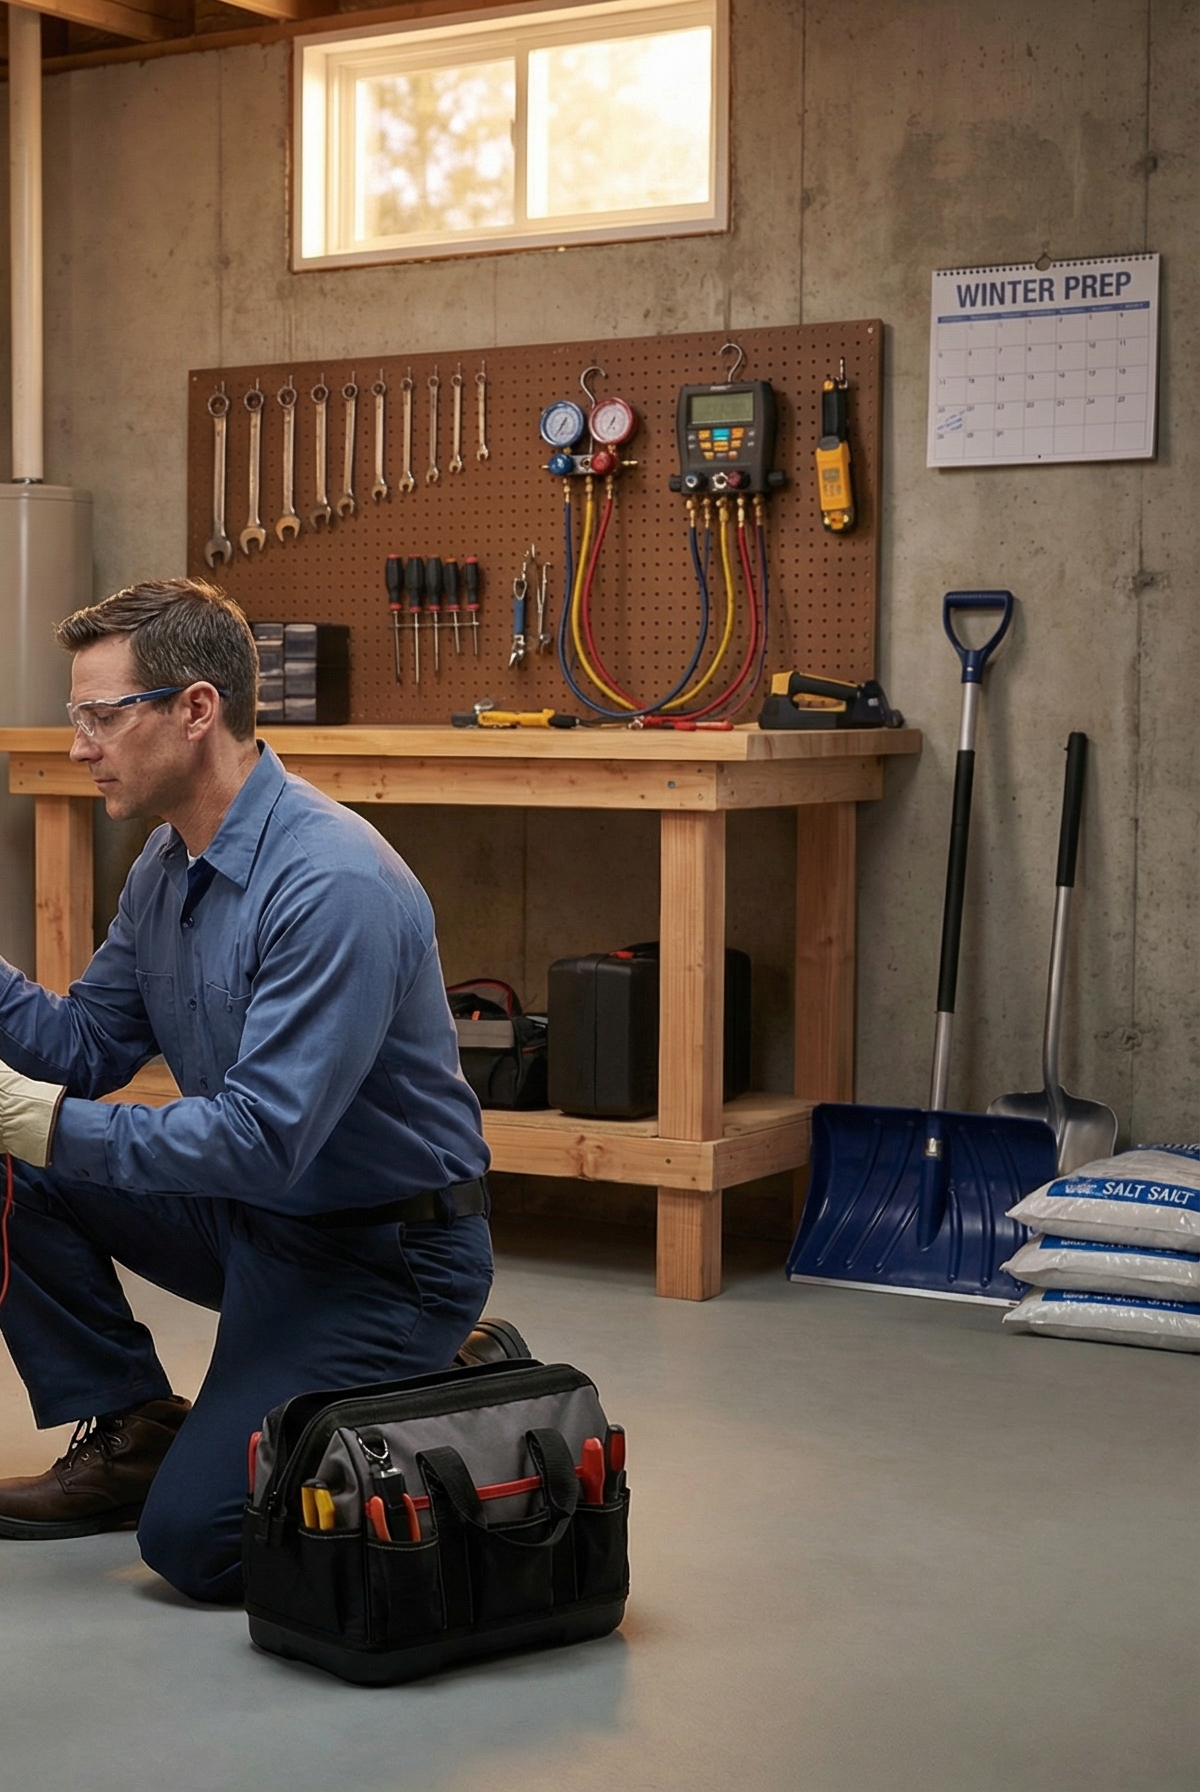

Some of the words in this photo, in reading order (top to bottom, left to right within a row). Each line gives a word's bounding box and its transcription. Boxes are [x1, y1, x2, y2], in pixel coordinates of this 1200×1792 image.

[956, 277, 1055, 309] WINTER
[1064, 271, 1132, 300] PREP
[1102, 1181, 1146, 1199] SALT
